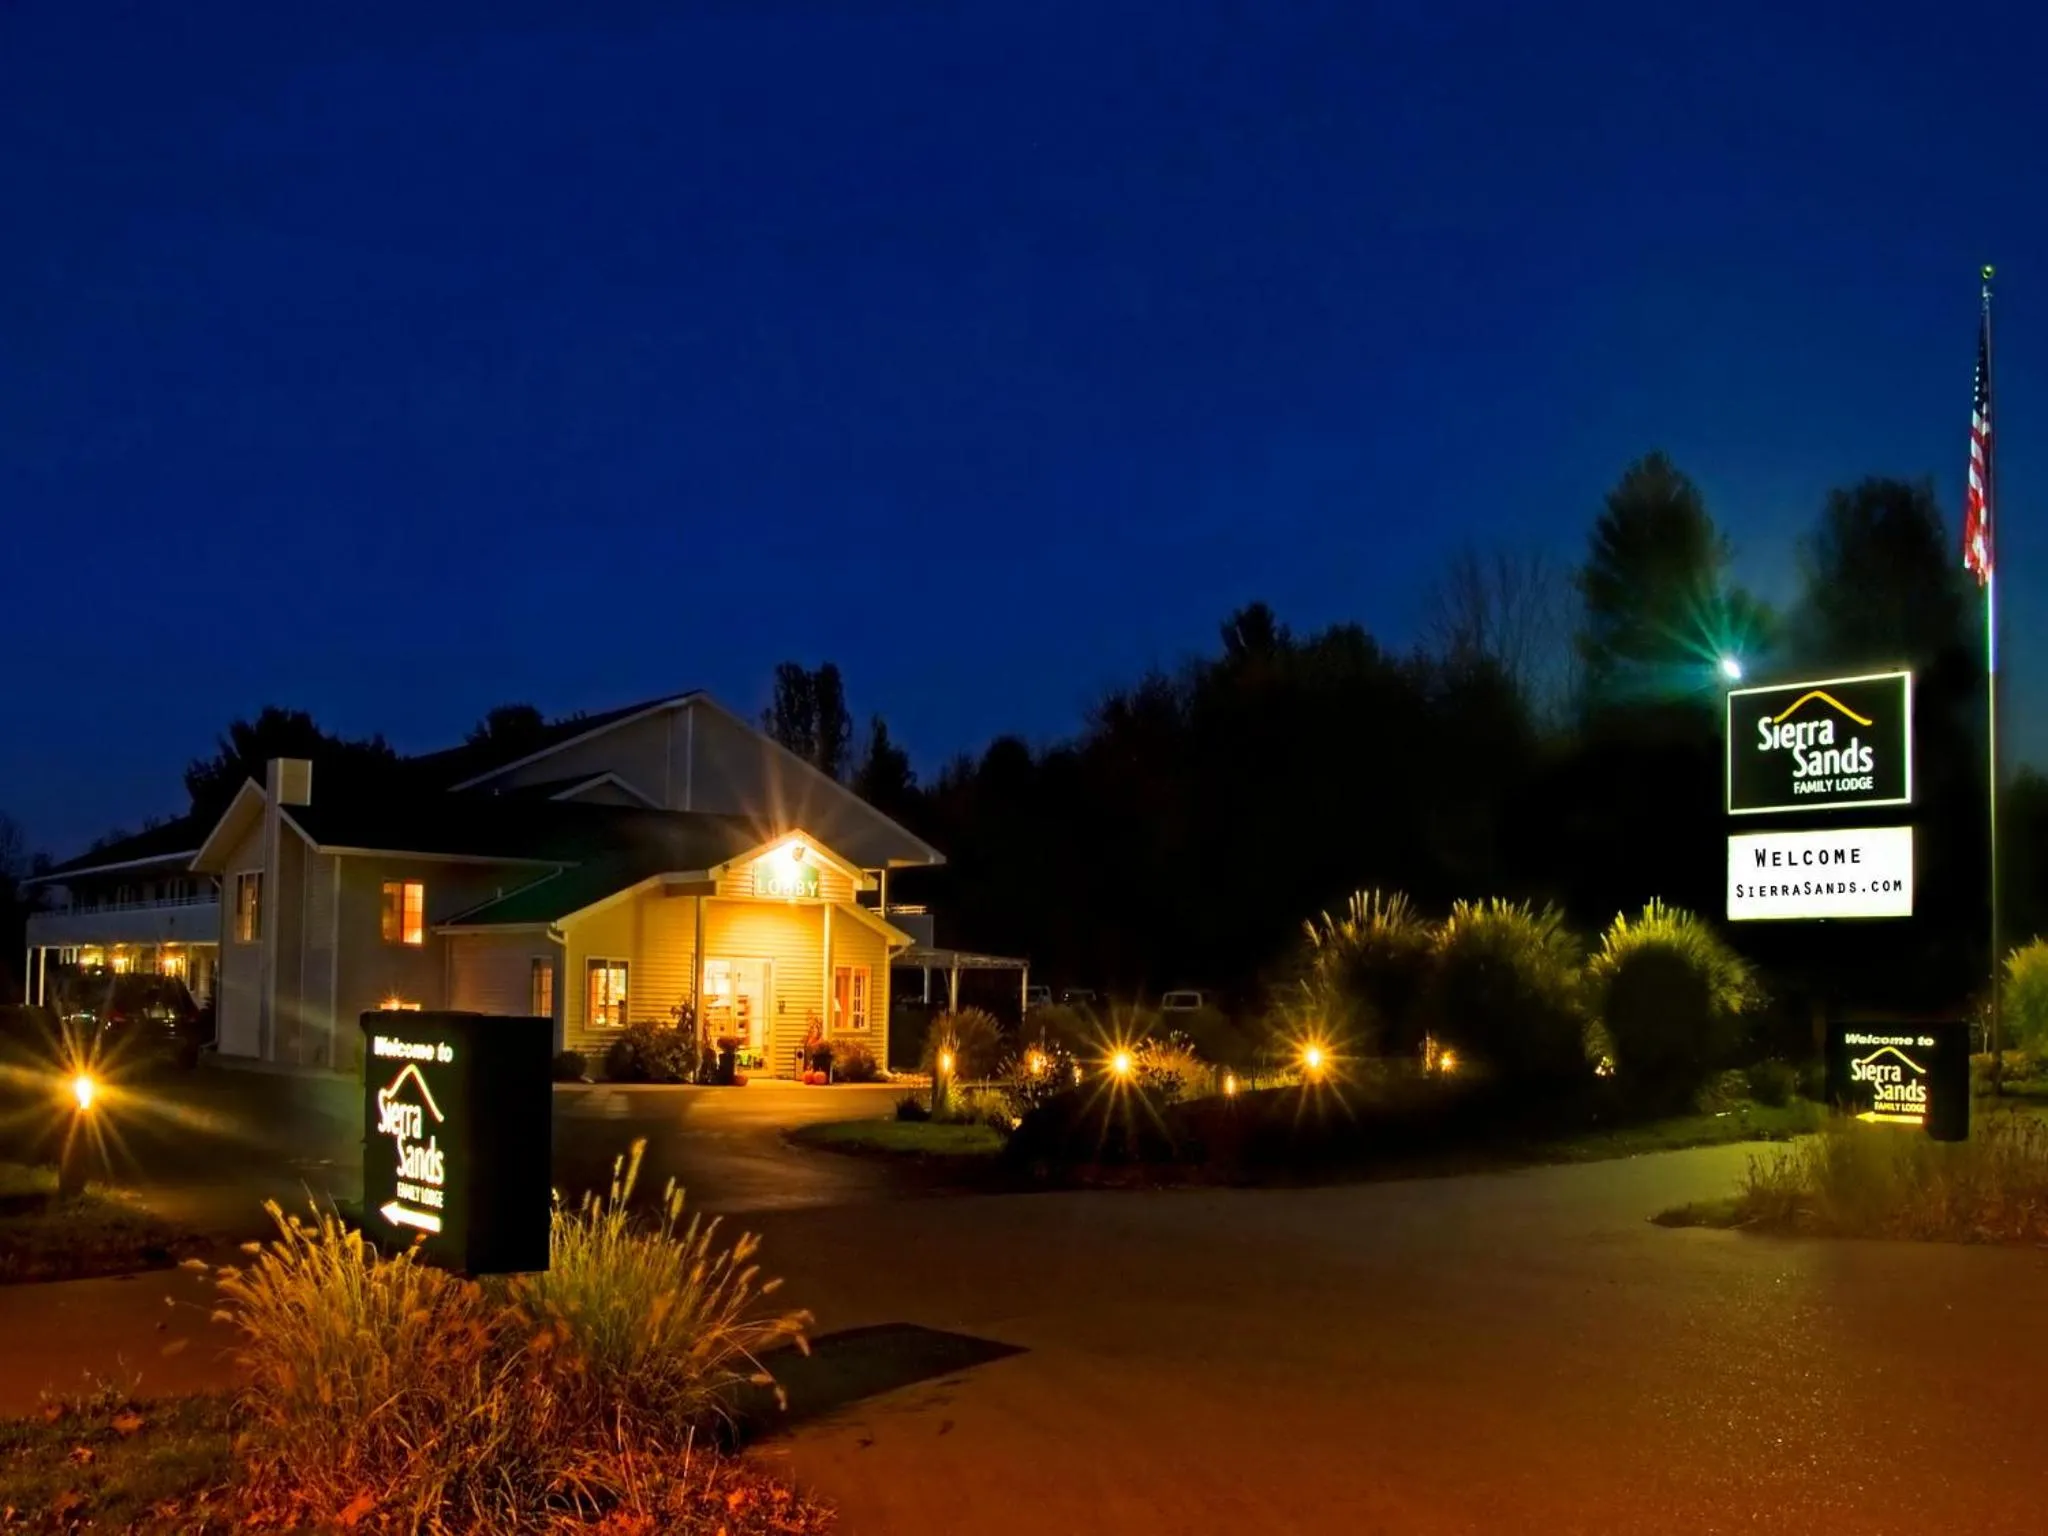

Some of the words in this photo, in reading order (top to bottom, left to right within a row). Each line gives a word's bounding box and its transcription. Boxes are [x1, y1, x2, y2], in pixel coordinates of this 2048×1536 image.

[1758, 717, 1834, 750] Sierra
[1793, 738, 1874, 778] Sands
[1793, 779, 1832, 794] FAMILY
[1836, 777, 1873, 791] LODGE
[374, 1036, 435, 1061] Welcome
[437, 1041, 453, 1063] to
[1845, 1033, 1914, 1046] Welcome
[1917, 1036, 1935, 1046] to
[1851, 1058, 1901, 1082] Sierra
[1874, 1079, 1927, 1102] Sands
[378, 1088, 422, 1139] Sierra
[397, 1135, 444, 1185] Sands
